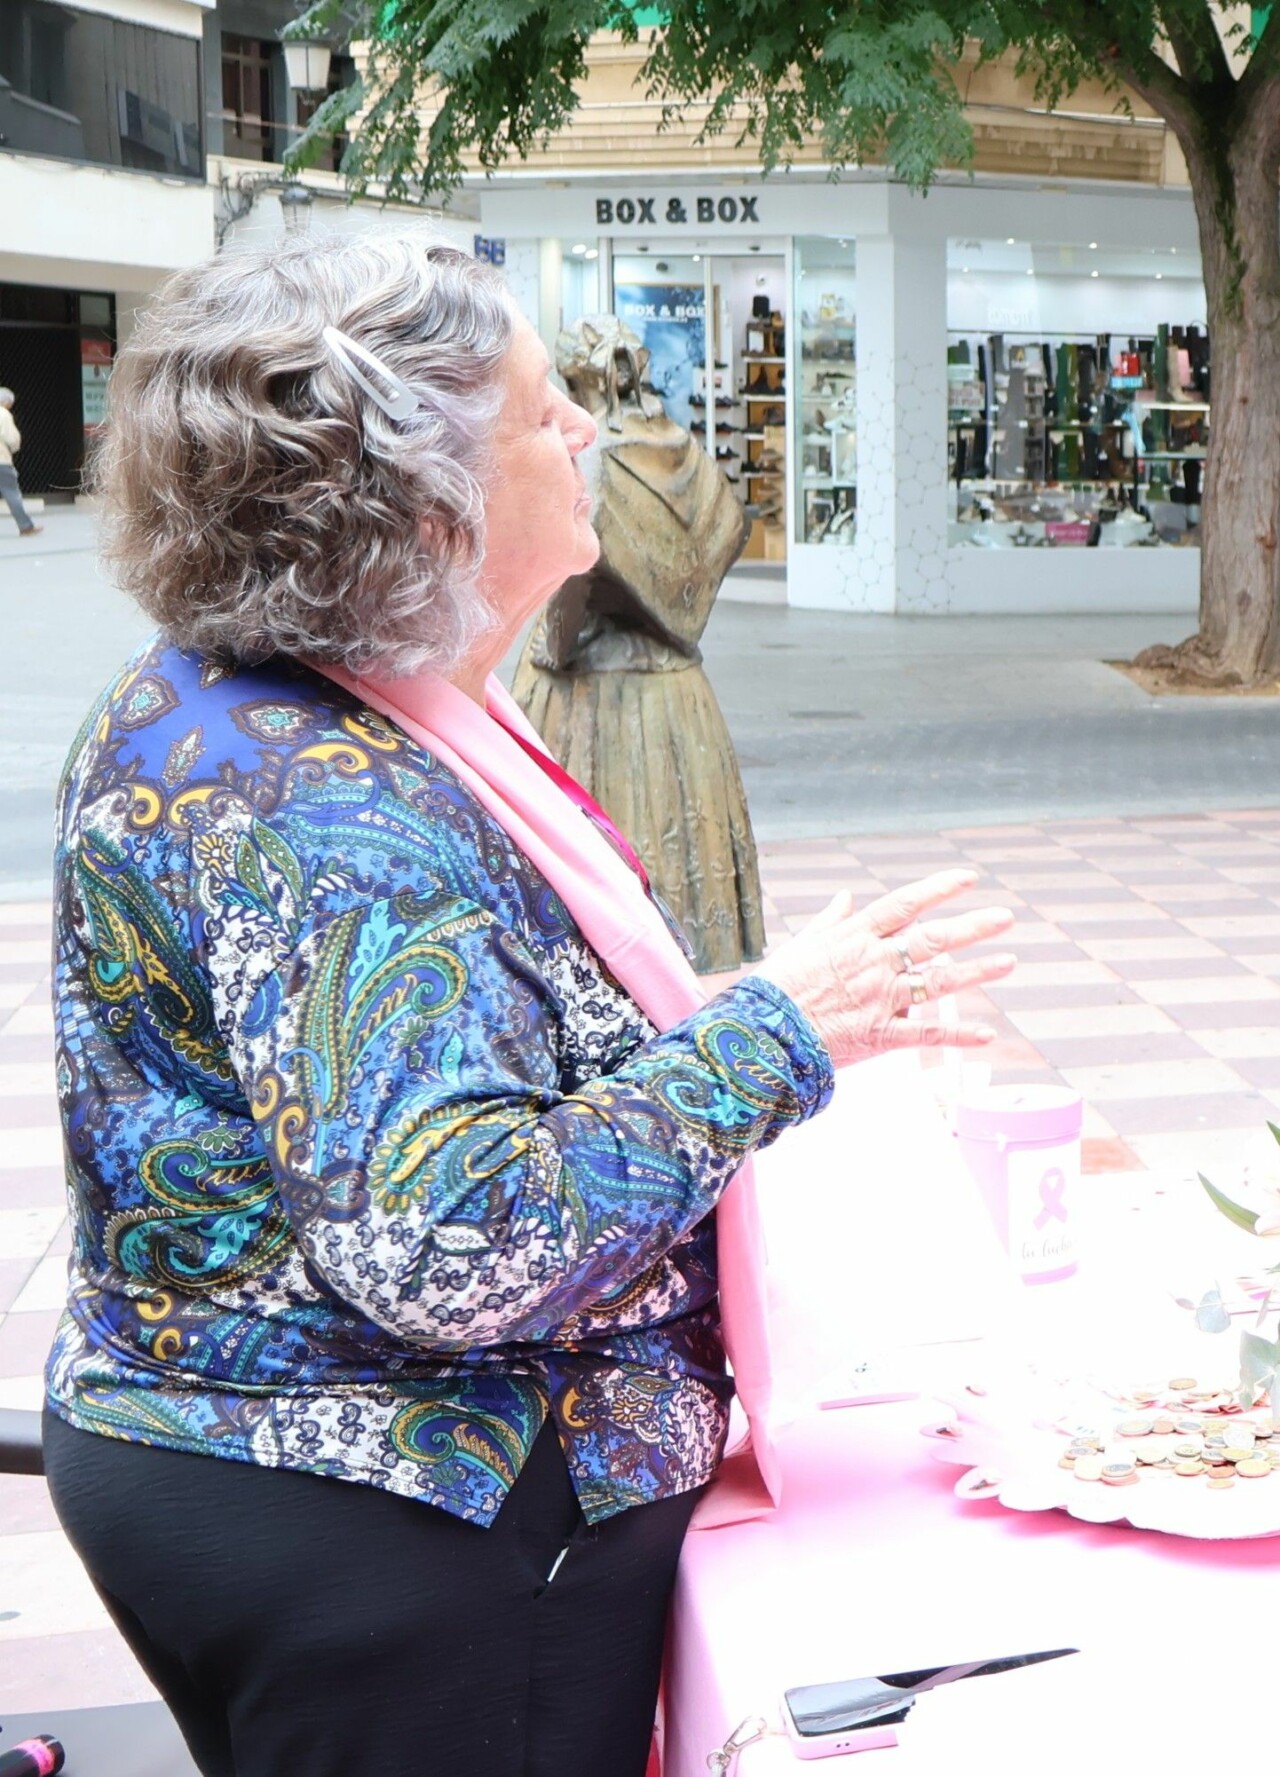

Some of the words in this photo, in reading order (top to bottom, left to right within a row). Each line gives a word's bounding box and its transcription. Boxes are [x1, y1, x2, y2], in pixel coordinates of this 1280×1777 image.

[596, 197, 657, 224] BOX
[665, 197, 688, 223] &
[697, 196, 760, 223] BOX
